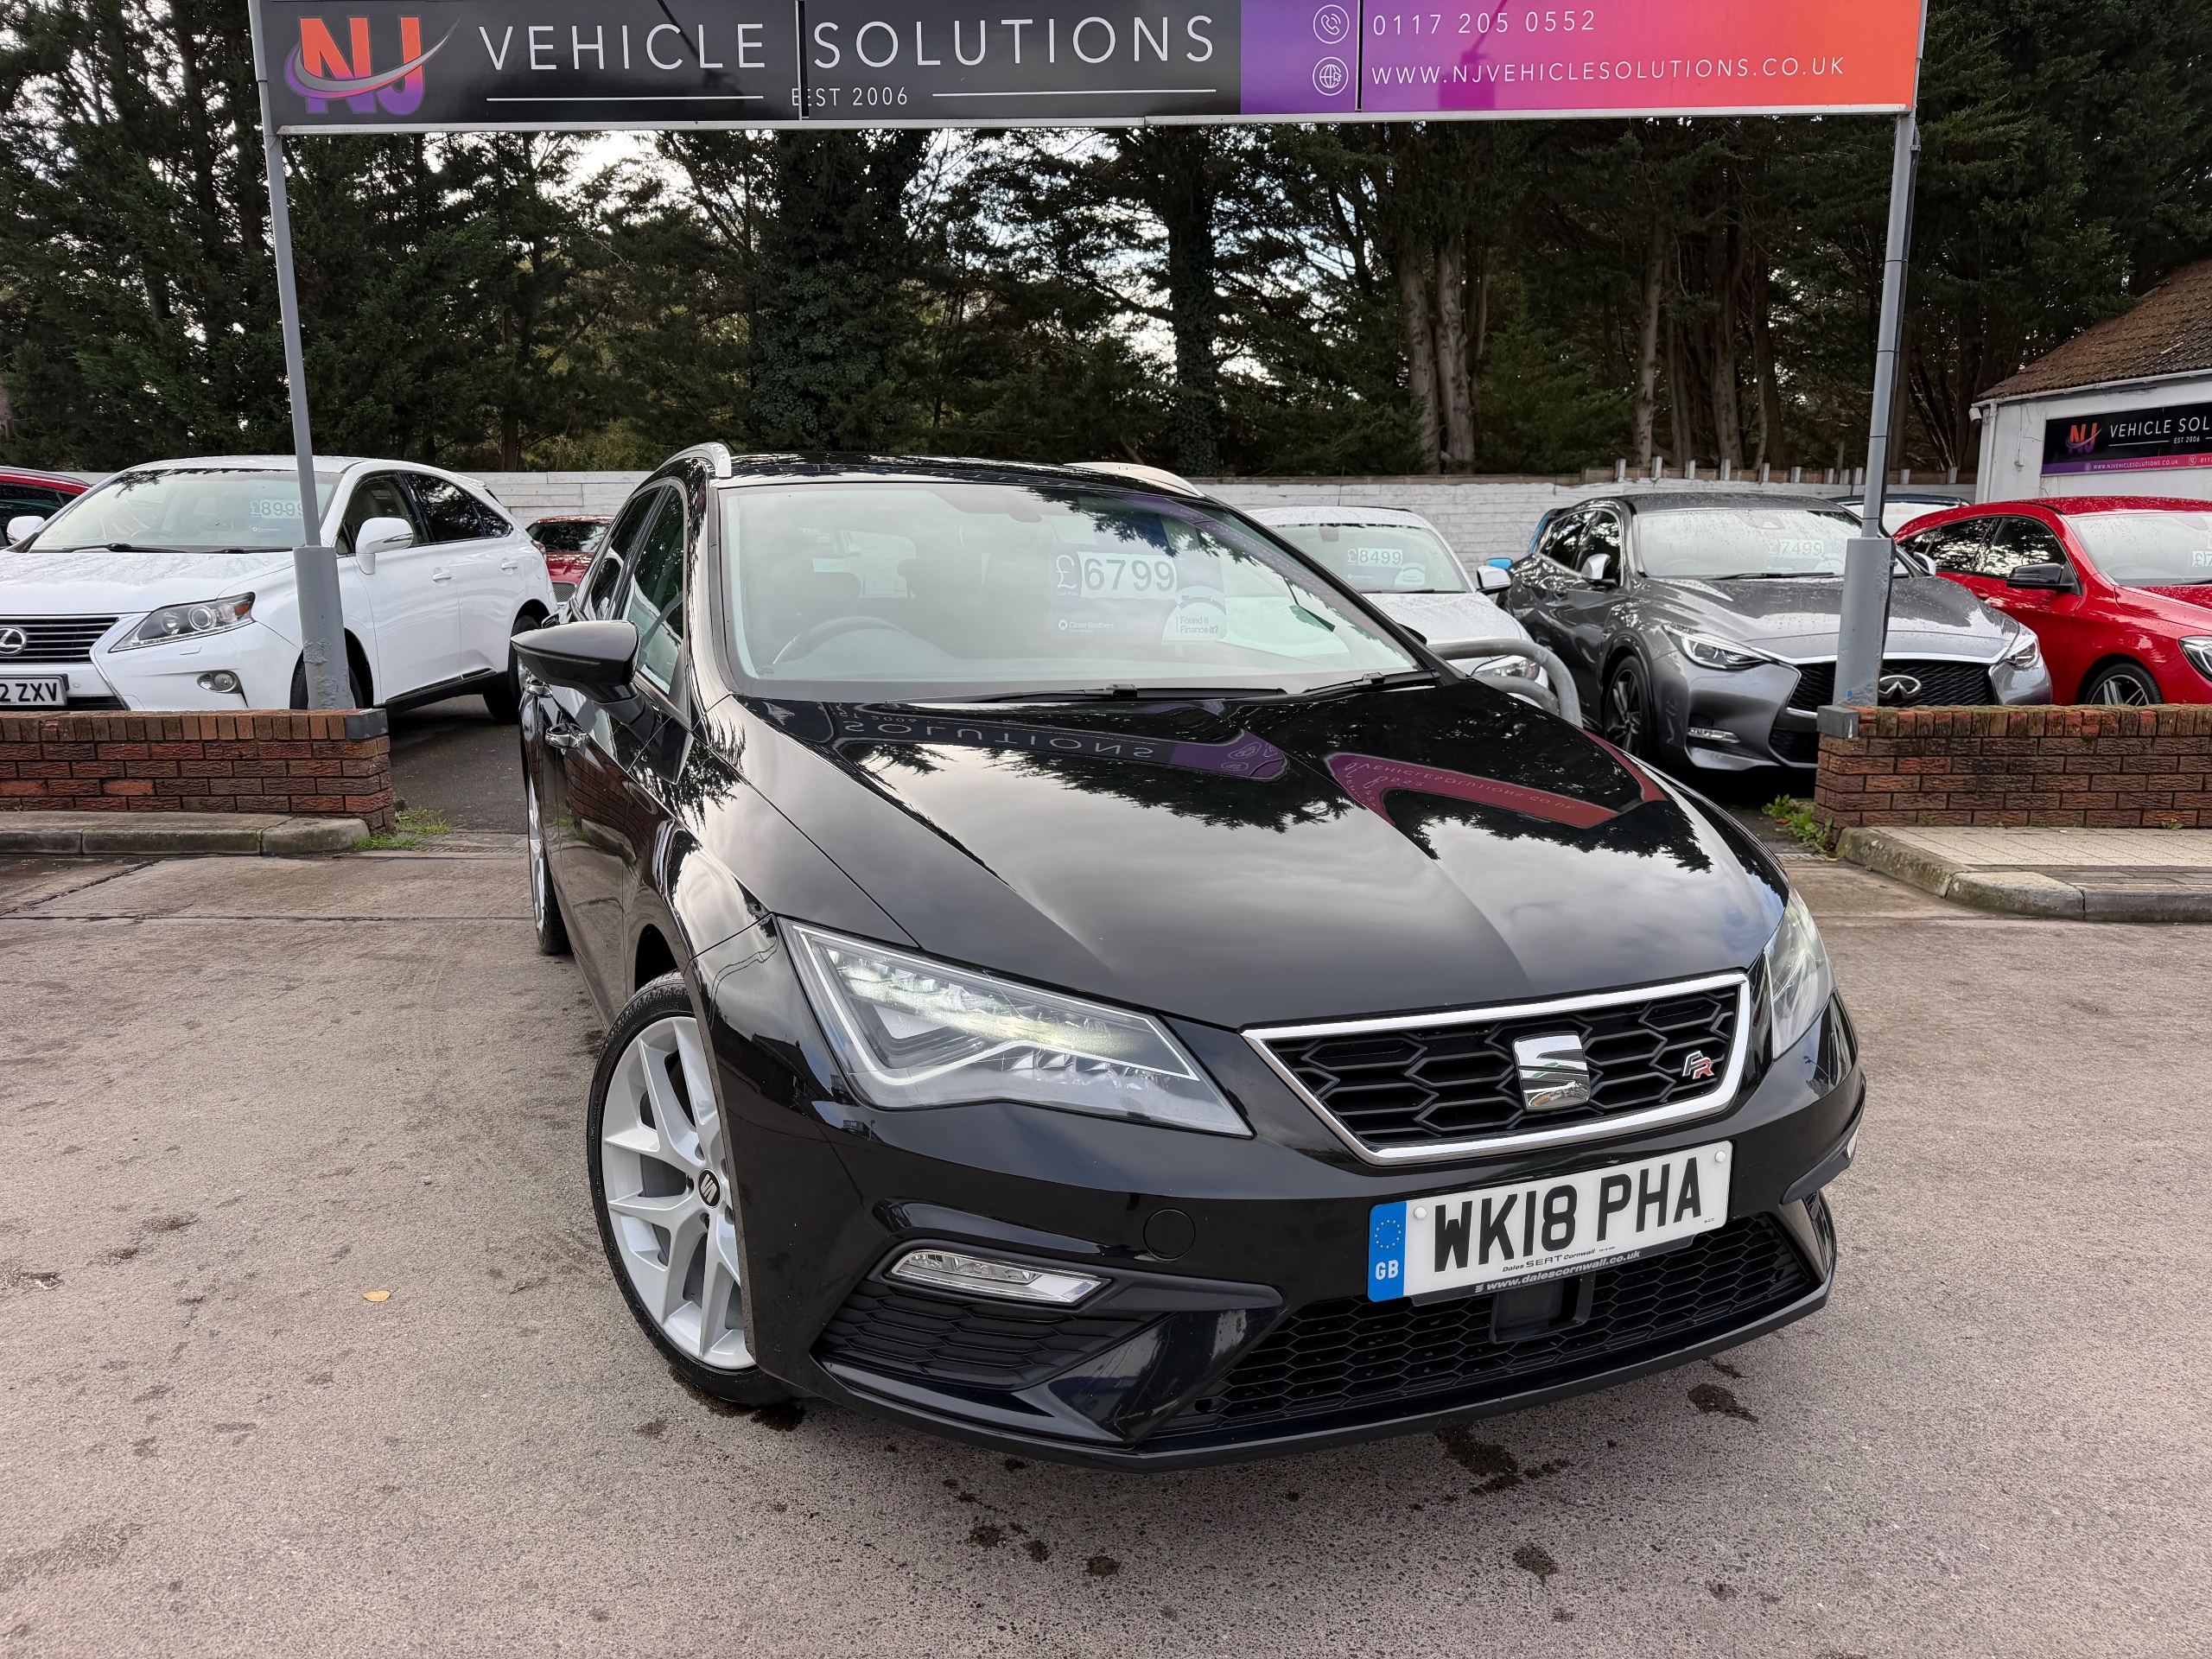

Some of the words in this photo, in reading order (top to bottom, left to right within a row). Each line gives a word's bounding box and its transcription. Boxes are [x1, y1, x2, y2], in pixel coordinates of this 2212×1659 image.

[1373, 15, 1441, 35] 0117
[1459, 13, 1509, 34] 205
[1526, 10, 1594, 32] 0552
[479, 23, 766, 70] VEHICLE
[814, 16, 1214, 68] SOLUTIONS
[299, 16, 424, 114] NJ
[1371, 57, 1844, 84] WWW.NJVEHICLESOLUTIONS.CO.UK
[852, 86, 907, 105] 2006
[2068, 423, 2098, 453] NJ
[2110, 419, 2171, 438] VEHICLE
[2178, 416, 2210, 433] SOL
[1348, 548, 1402, 565] £8499
[1055, 554, 1175, 592] £6799
[16, 683, 57, 702] ZXV
[1434, 1184, 1577, 1273] WK18
[1596, 1156, 1702, 1242] PHA
[1375, 1260, 1399, 1280] GB
[1486, 1250, 1642, 1291] www.dalescornwall.co.uk
[1502, 1264, 1524, 1273] Dales
[1525, 1254, 1562, 1268] SEAT
[1563, 1248, 1596, 1260] Cornwall
